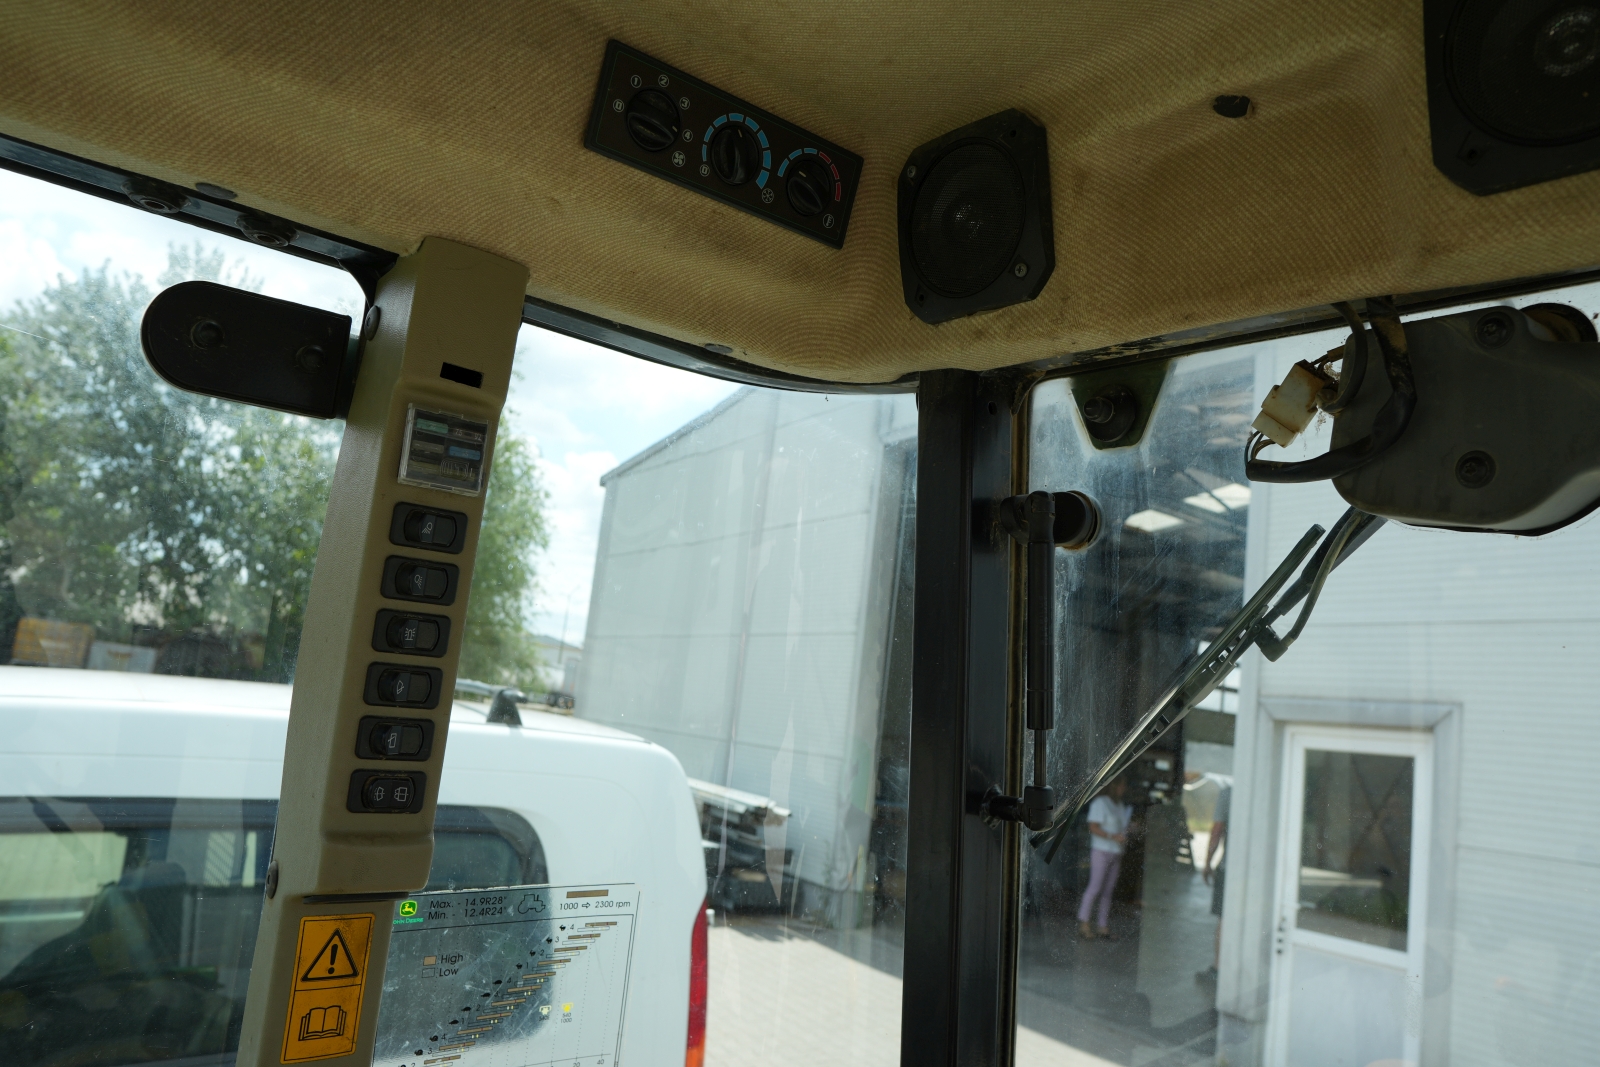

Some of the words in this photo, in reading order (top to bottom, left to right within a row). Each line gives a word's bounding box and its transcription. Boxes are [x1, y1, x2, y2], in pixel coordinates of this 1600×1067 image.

[429, 899, 454, 909] Max.
[559, 902, 579, 911] 1000
[594, 900, 614, 909] 2300
[615, 900, 631, 909] rpm
[427, 911, 449, 920] Min.
[440, 953, 464, 965] High
[438, 967, 459, 977] Low
